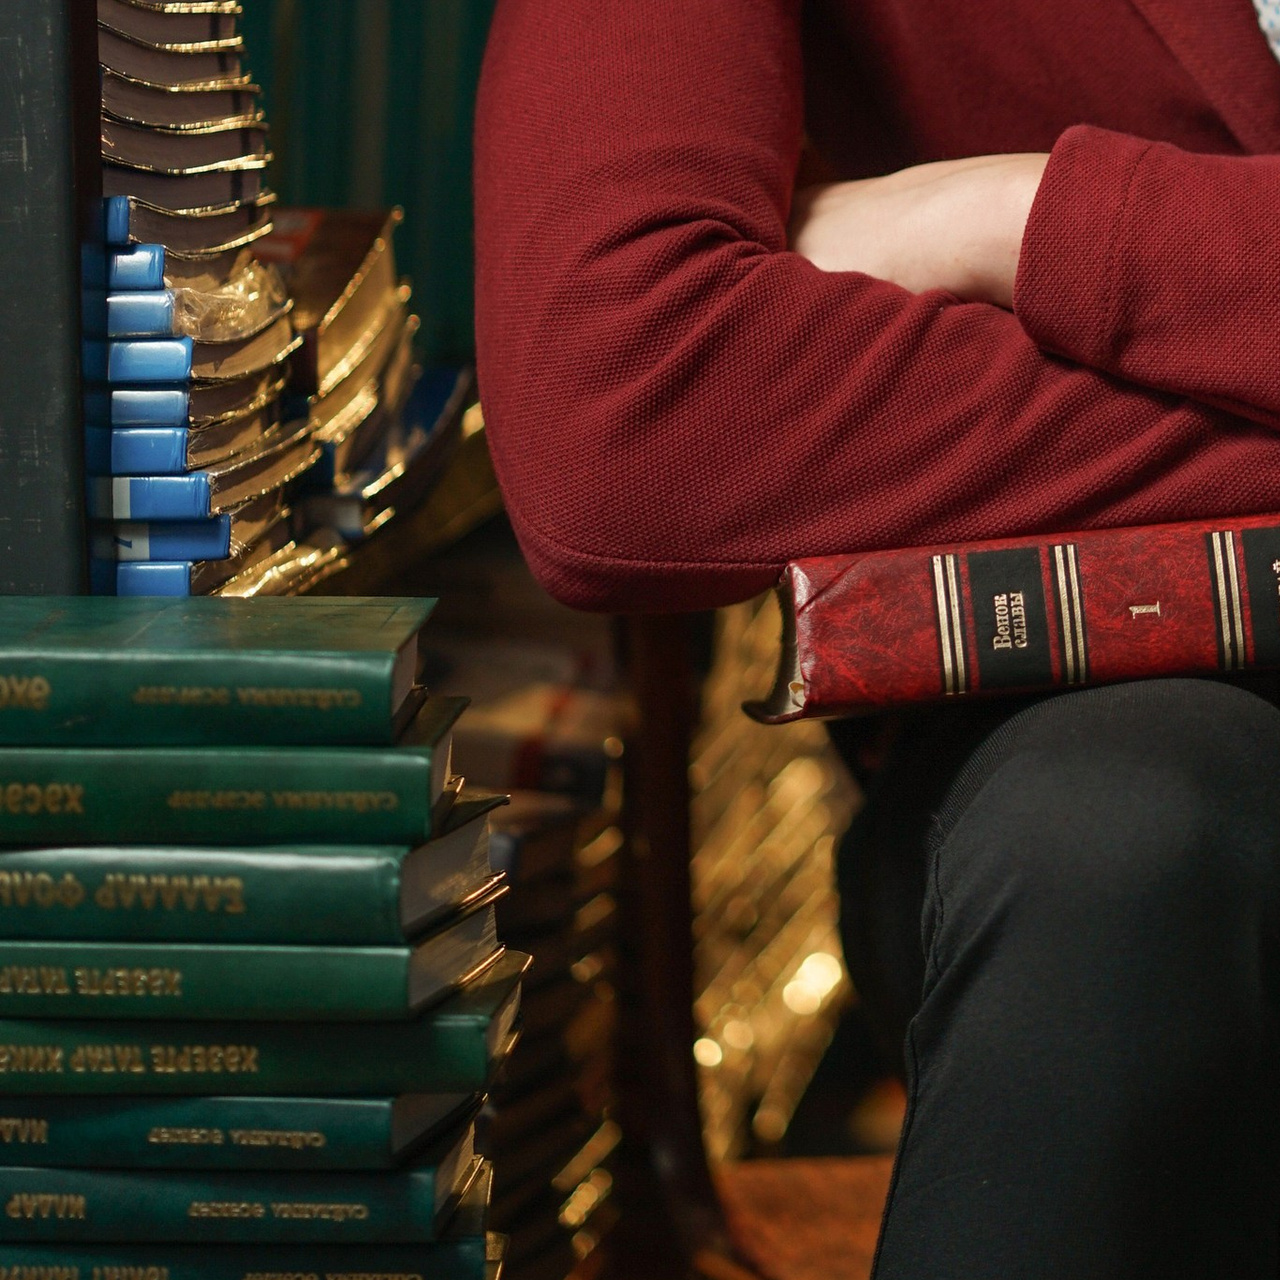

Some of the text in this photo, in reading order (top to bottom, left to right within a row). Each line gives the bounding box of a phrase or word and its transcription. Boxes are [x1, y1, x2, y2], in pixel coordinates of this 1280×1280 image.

[993, 593, 1013, 650] Венок
[1010, 591, 1028, 649] славы
[1129, 600, 1161, 620] 1
[0, 783, 85, 815] ХӘСӘ
[71, 1045, 146, 1072] ТАТАР
[6, 1194, 86, 1220] ИЛДАР
